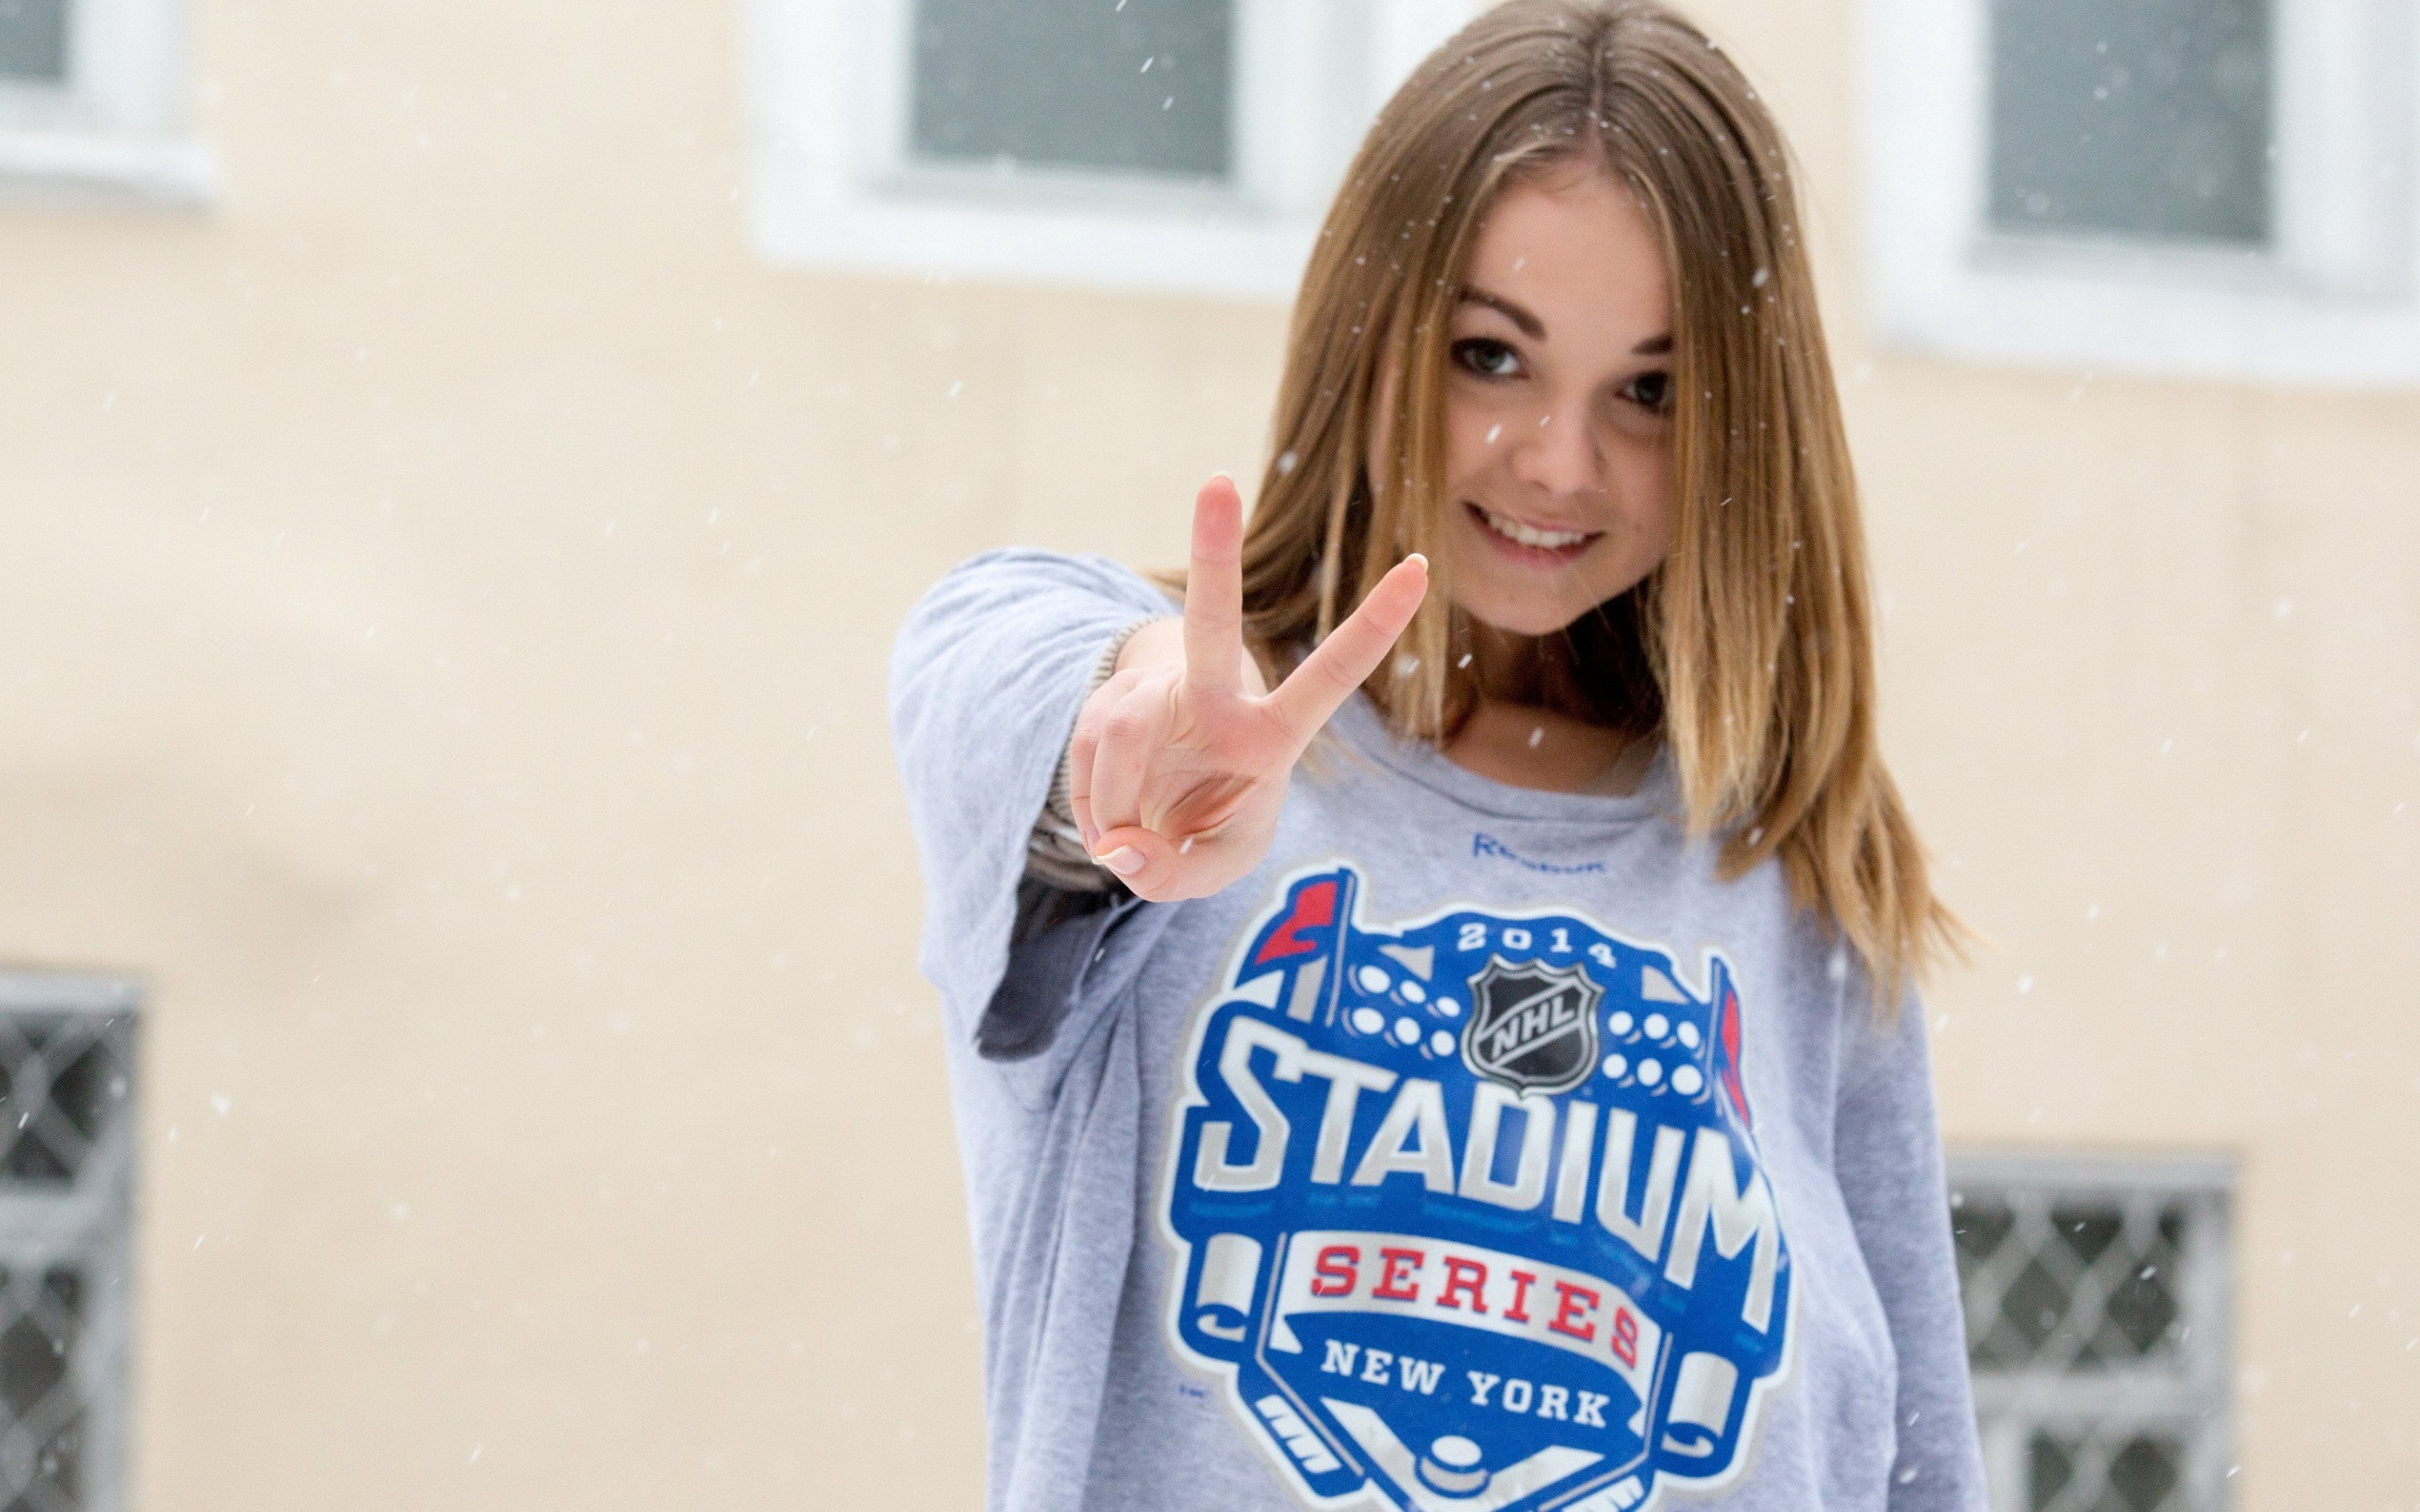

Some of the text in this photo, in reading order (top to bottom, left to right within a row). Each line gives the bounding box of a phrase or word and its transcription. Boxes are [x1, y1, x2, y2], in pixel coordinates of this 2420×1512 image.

[1456, 922, 1617, 969] 2014
[1491, 995, 1575, 1059] NHL
[1192, 1015, 1779, 1334] STADIUM
[1310, 1245, 1639, 1369] SERIES
[1320, 1339, 1610, 1428] NEW YORK
